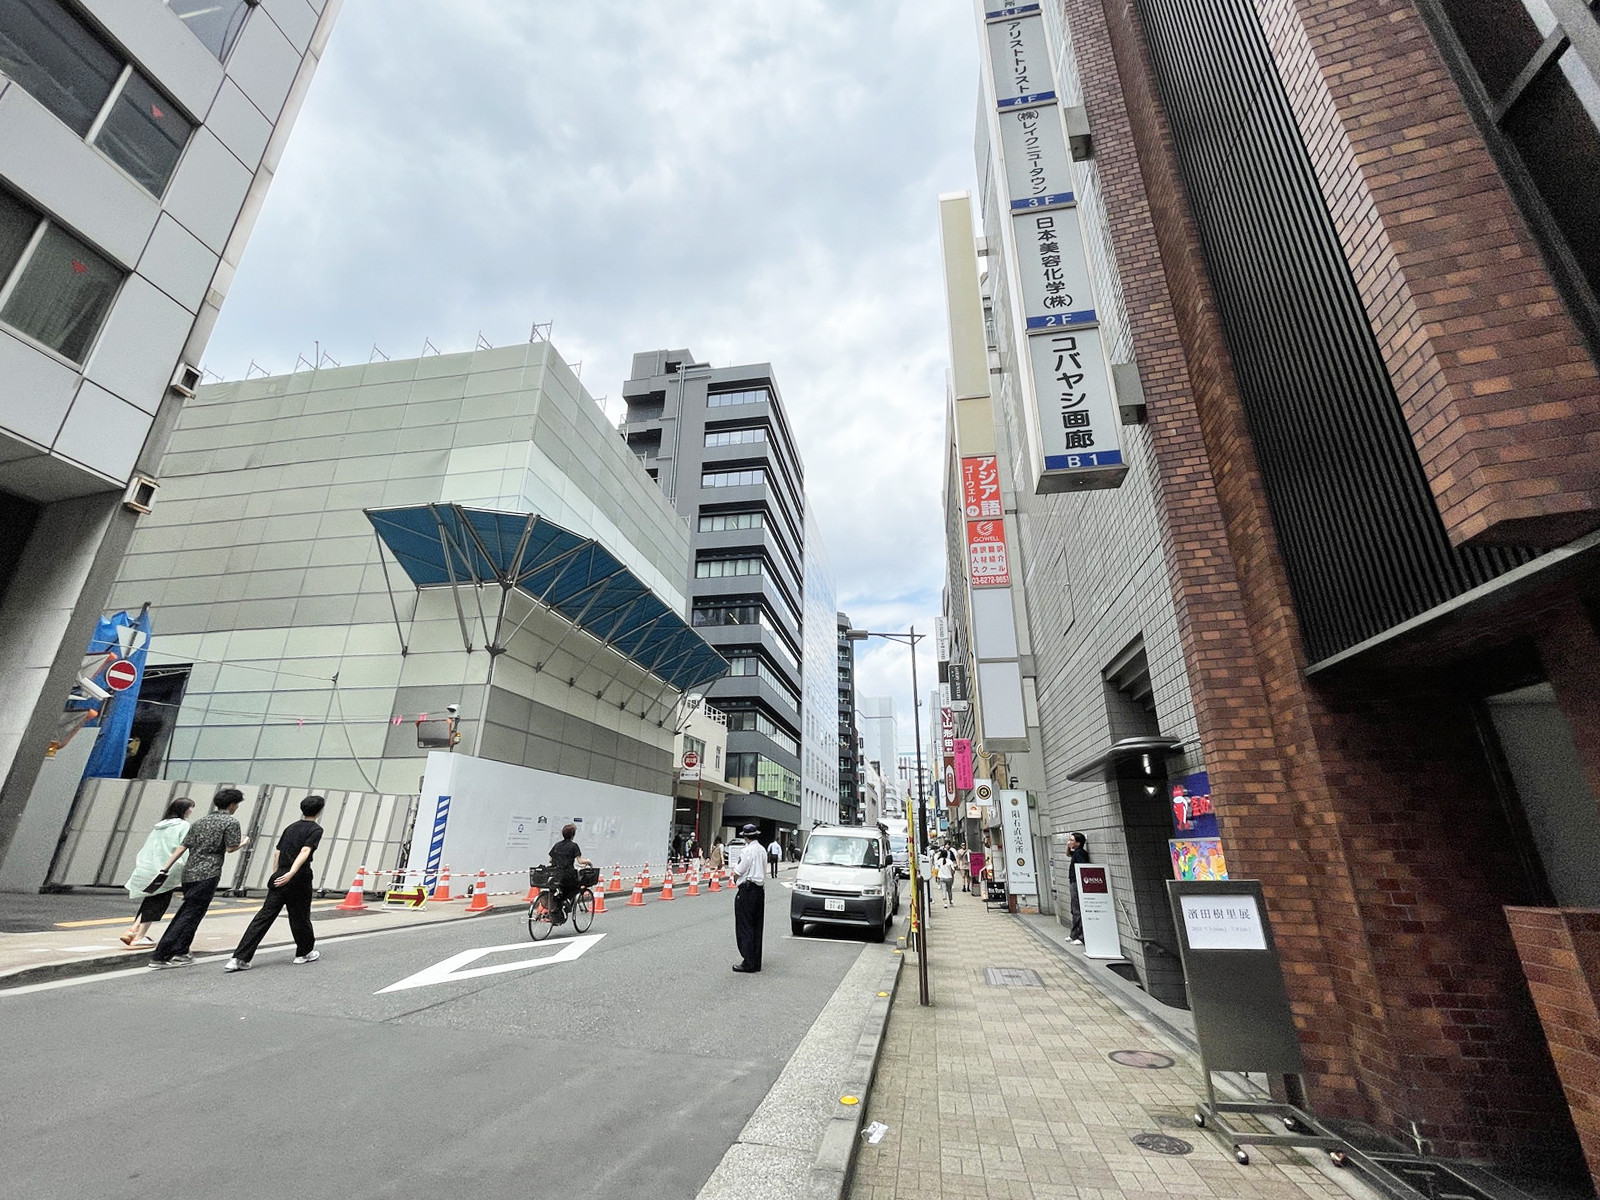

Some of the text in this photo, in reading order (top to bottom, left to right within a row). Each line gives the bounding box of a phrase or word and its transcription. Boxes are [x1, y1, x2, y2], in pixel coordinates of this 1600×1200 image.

[1007, 21, 1030, 94] アリストトリスト
[1036, 216, 1073, 309] 日本美容化学(株)
[1051, 337, 1095, 449] コバヤシ画廊
[965, 465, 976, 503] ゴーウェル
[977, 457, 1001, 516] アジア語
[972, 555, 1005, 564] 人材紹介
